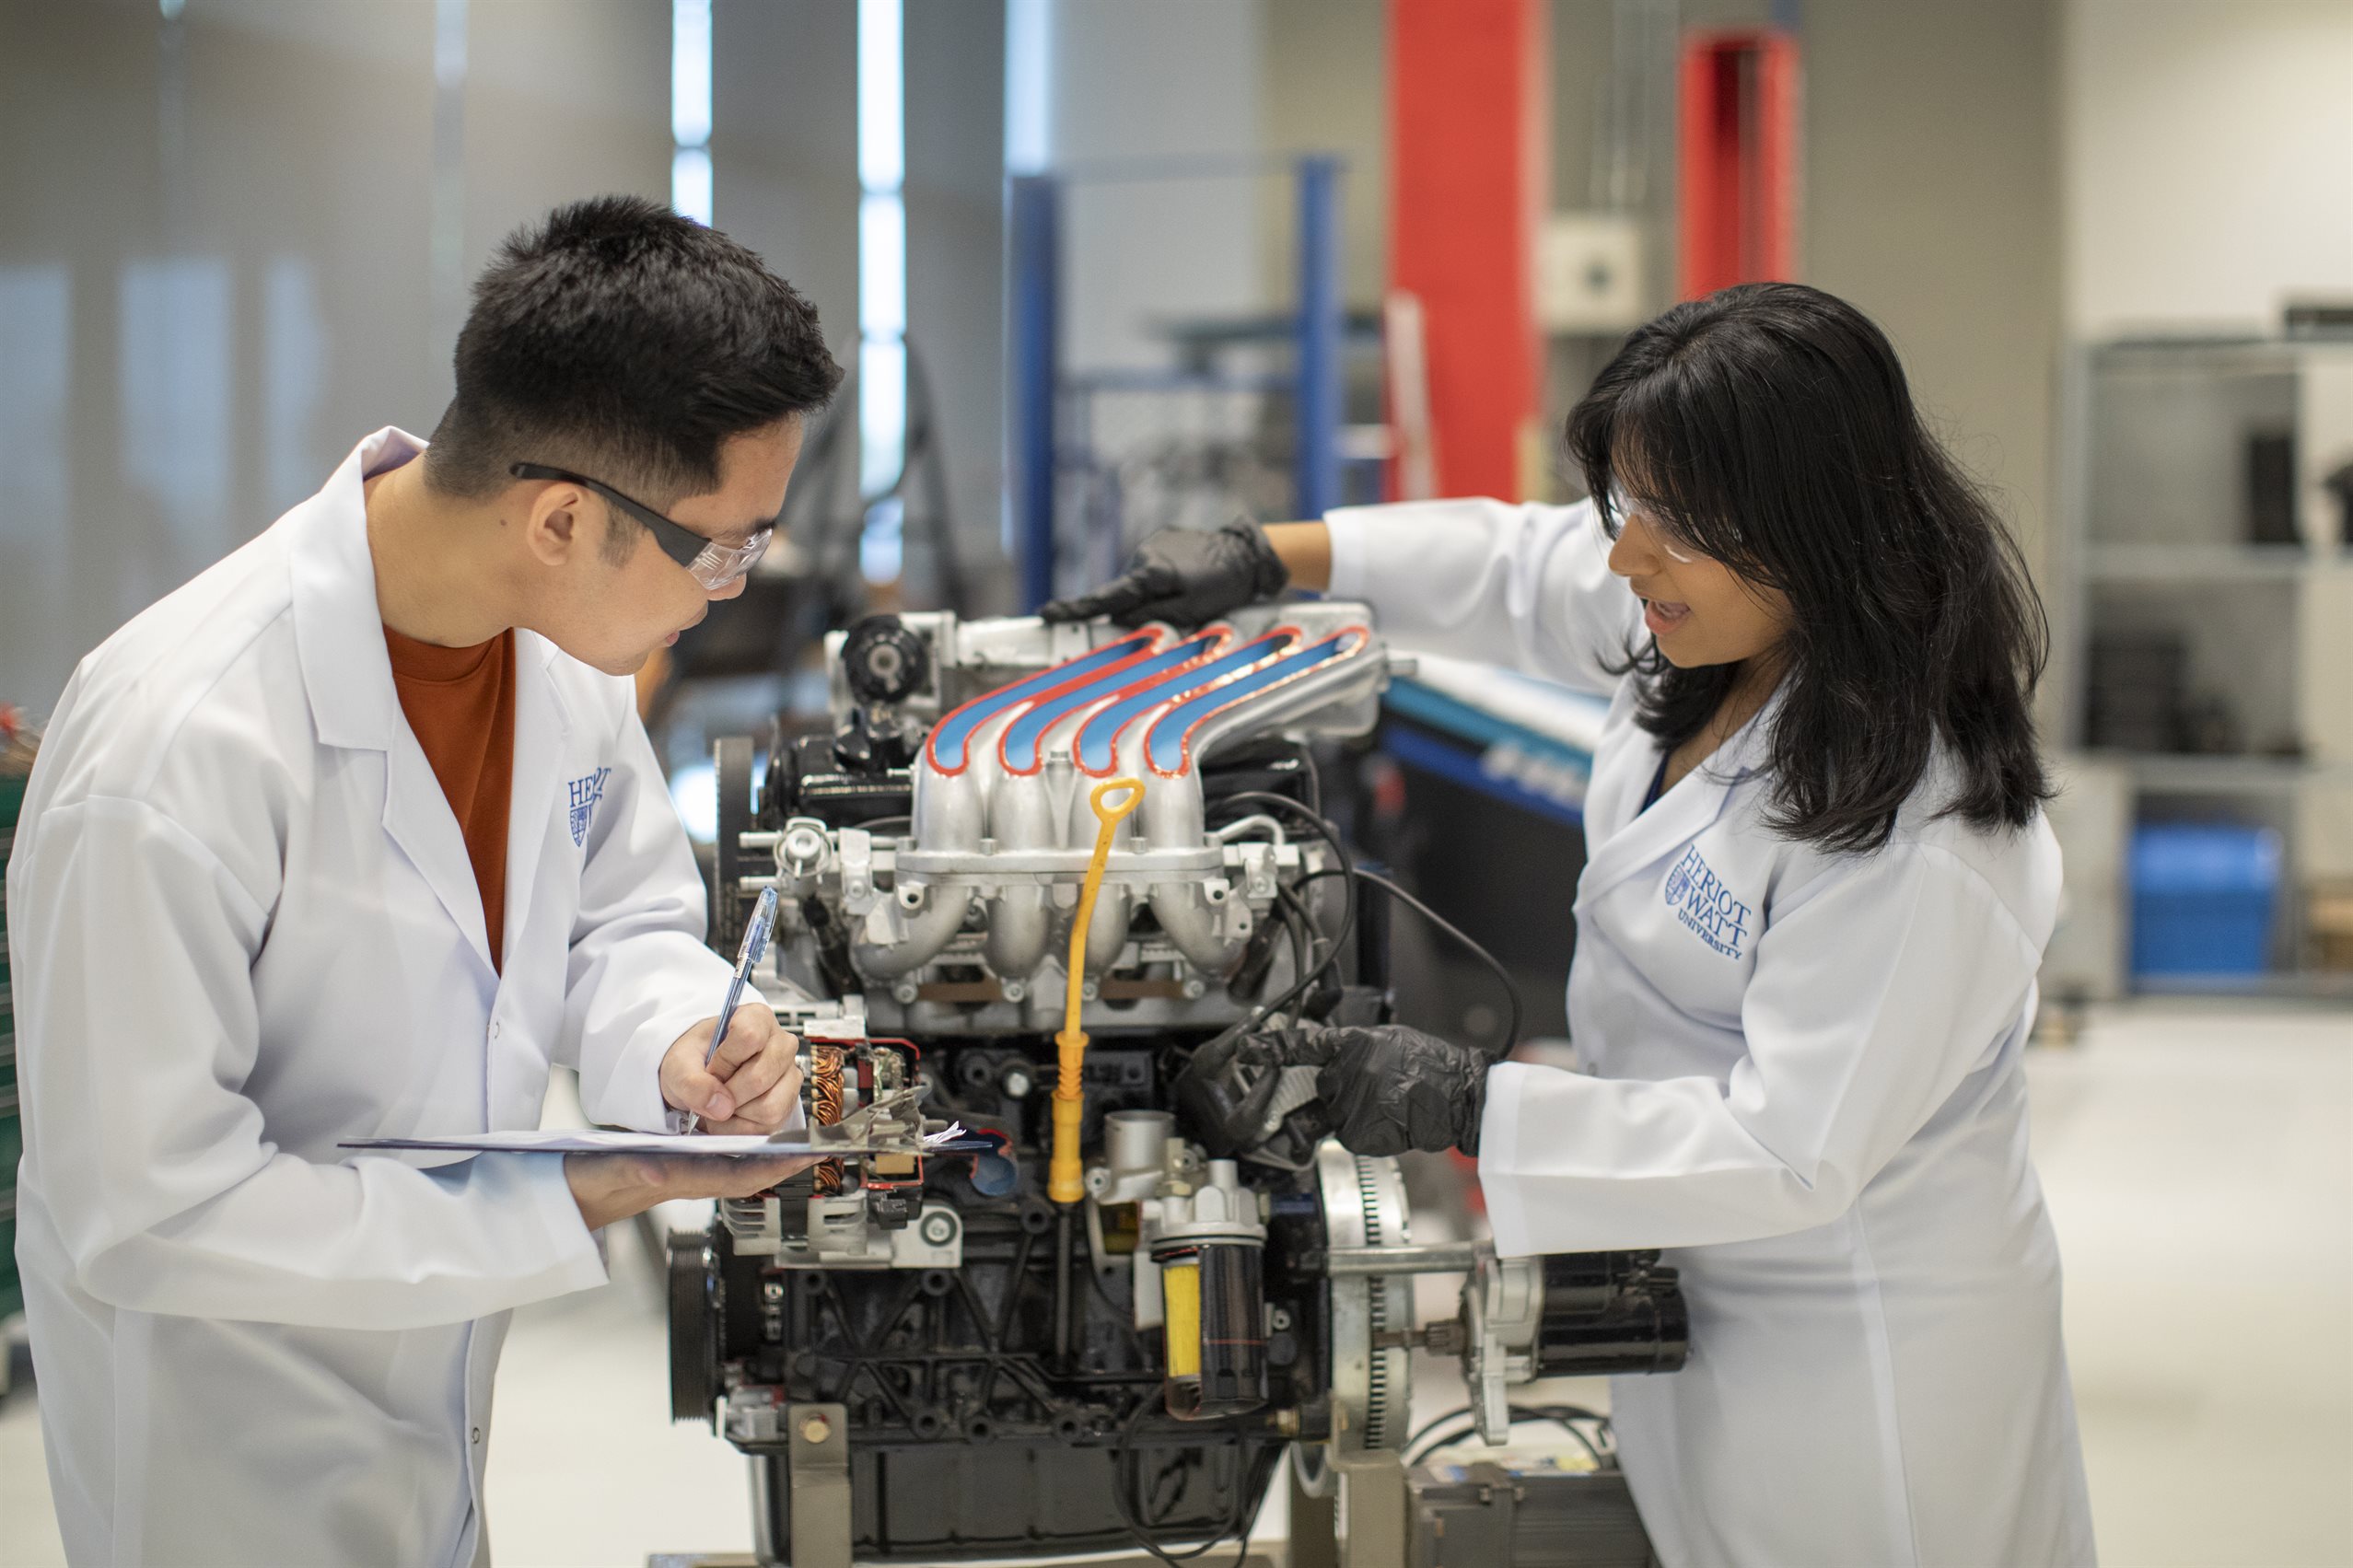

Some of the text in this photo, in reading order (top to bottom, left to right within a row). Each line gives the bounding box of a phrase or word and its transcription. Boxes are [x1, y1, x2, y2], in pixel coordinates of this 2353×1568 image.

[1681, 842, 1752, 926] HERIOT
[1686, 884, 1747, 947] WATT
[1678, 908, 1742, 960] UNIVERSITY
